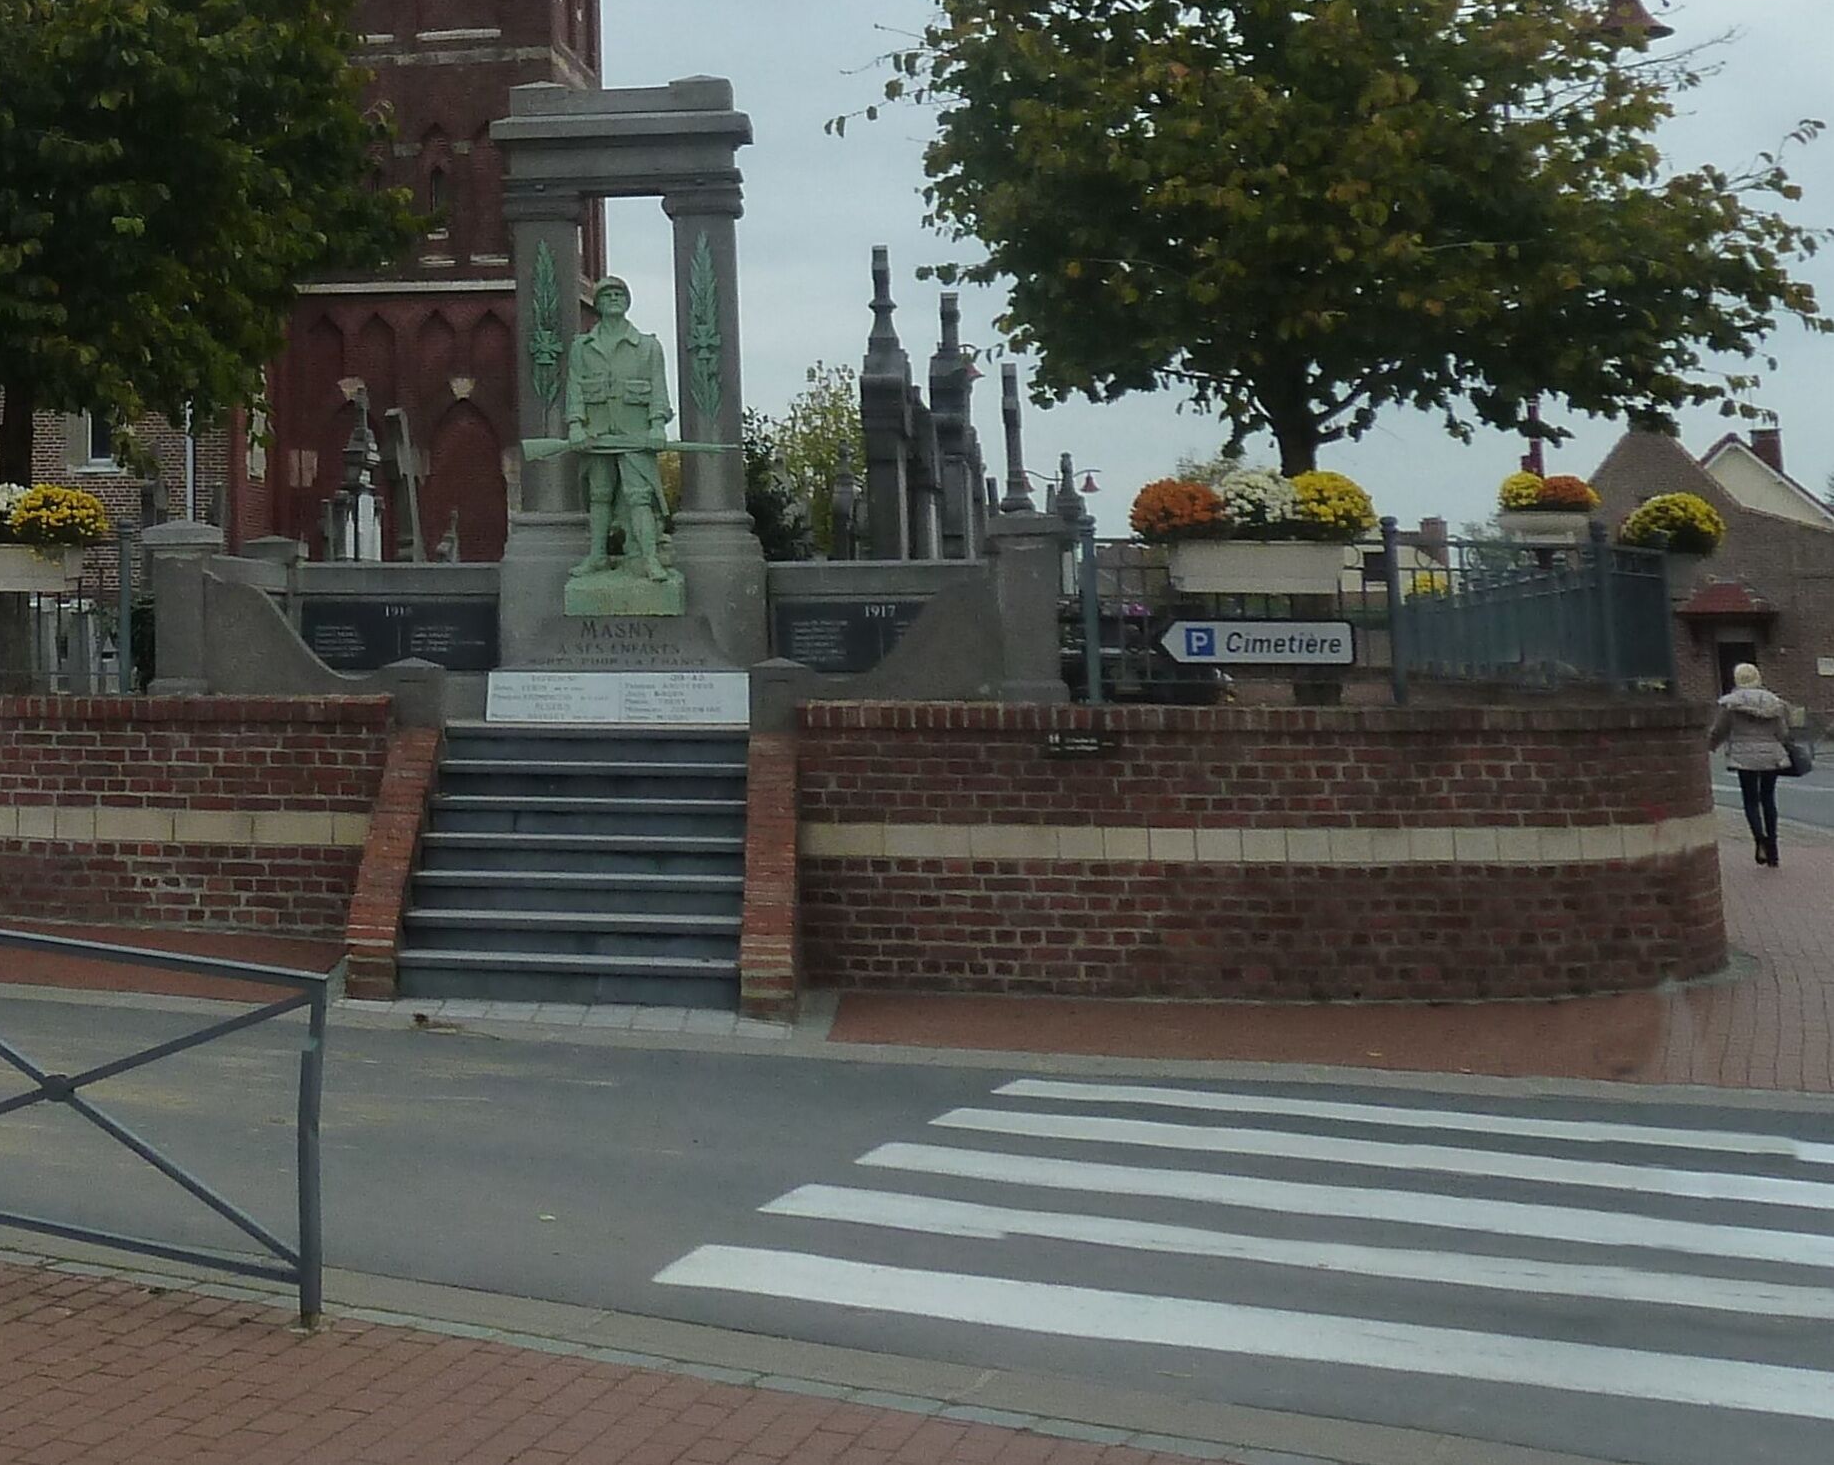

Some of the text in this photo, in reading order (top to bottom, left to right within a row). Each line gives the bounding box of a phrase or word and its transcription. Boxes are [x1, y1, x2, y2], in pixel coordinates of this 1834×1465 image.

[864, 604, 897, 619] 1917
[580, 619, 659, 640] MASNY
[611, 643, 681, 655] ENFANTS
[1190, 631, 1343, 654] P Cimetière
